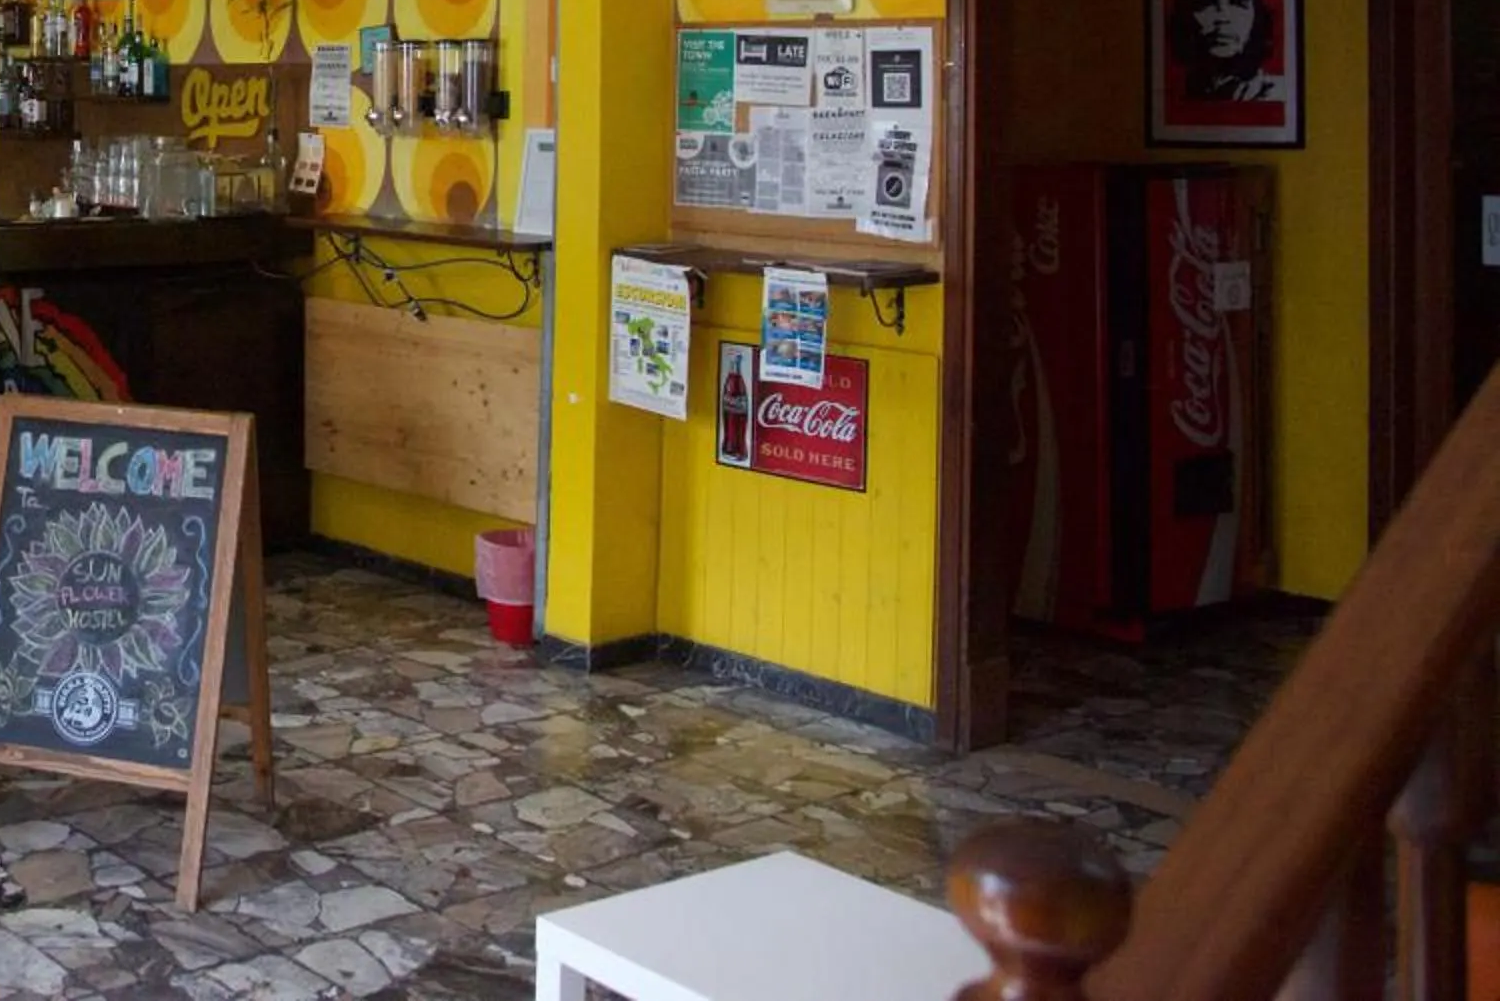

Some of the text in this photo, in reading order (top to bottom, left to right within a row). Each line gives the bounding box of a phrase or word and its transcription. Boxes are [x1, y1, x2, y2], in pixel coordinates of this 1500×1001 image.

[777, 44, 805, 58] LATE
[182, 67, 270, 149] Open
[758, 392, 860, 443] Coca-Cola
[19, 431, 216, 500] WELCOME
[761, 443, 856, 471] SOLD HERE
[72, 558, 122, 583] SUN
[66, 609, 127, 629] HOSTEL
